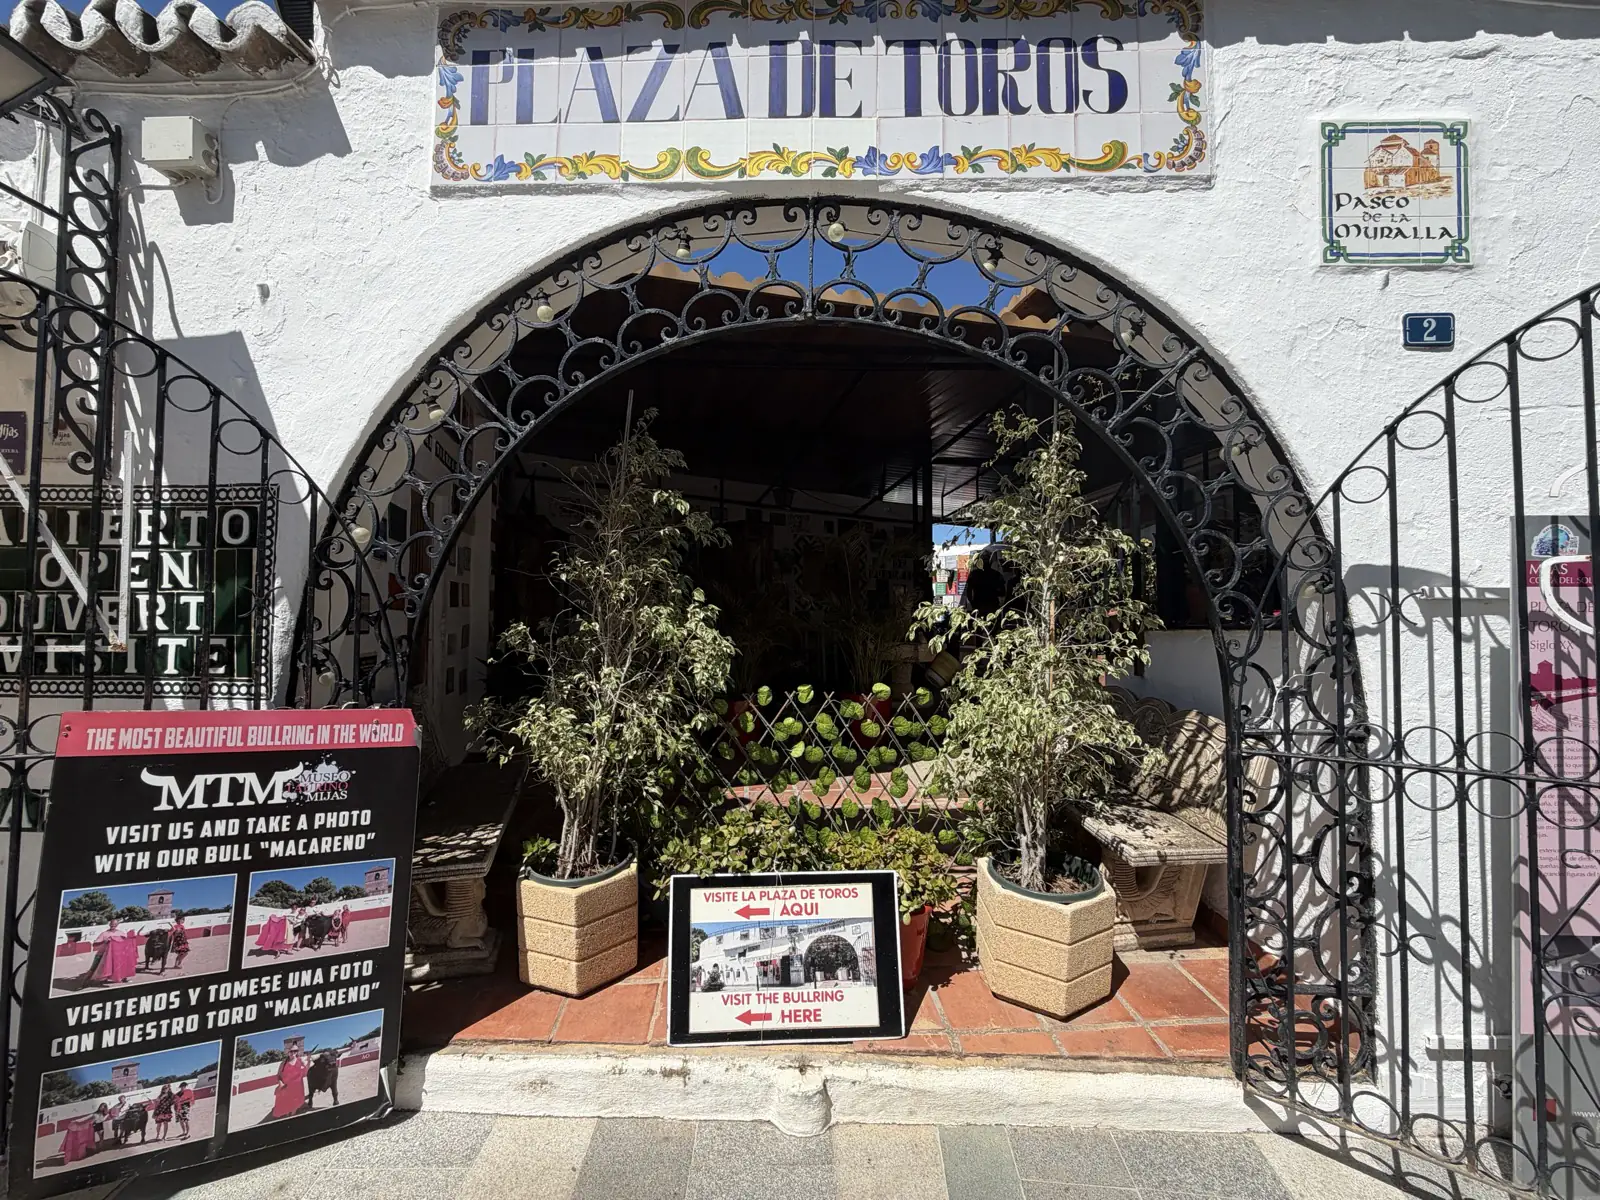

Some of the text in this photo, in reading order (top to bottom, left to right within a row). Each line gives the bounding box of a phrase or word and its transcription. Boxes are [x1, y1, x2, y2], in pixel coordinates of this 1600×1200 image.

[469, 37, 1129, 125] PLAZA DE TOROS
[1422, 318, 1437, 342] 2
[39, 551, 194, 589] OPEN
[87, 723, 405, 750] THE MOST BEAUTIFUL BULLRING IN THE WORLD
[141, 762, 304, 811] MTM
[300, 771, 351, 783] MUSEO
[306, 790, 348, 802] MIJAS
[106, 809, 372, 845] VISIT US AND TAKE A PHOTO
[95, 852, 150, 874] WITH
[156, 847, 198, 868] OUR
[205, 842, 253, 865] BULL
[704, 887, 859, 903] VISITE LA PLAZA DE TOROS
[780, 902, 819, 917] AQUI
[66, 959, 374, 1027] VISITENOS Y TOMESE UNA FOTO
[721, 990, 845, 1006] VISIT THE BULLRING
[781, 1008, 822, 1024] HERE
[50, 1031, 95, 1058] CON
[102, 1013, 199, 1049] NUESTRO
[206, 1004, 257, 1029] TORO
